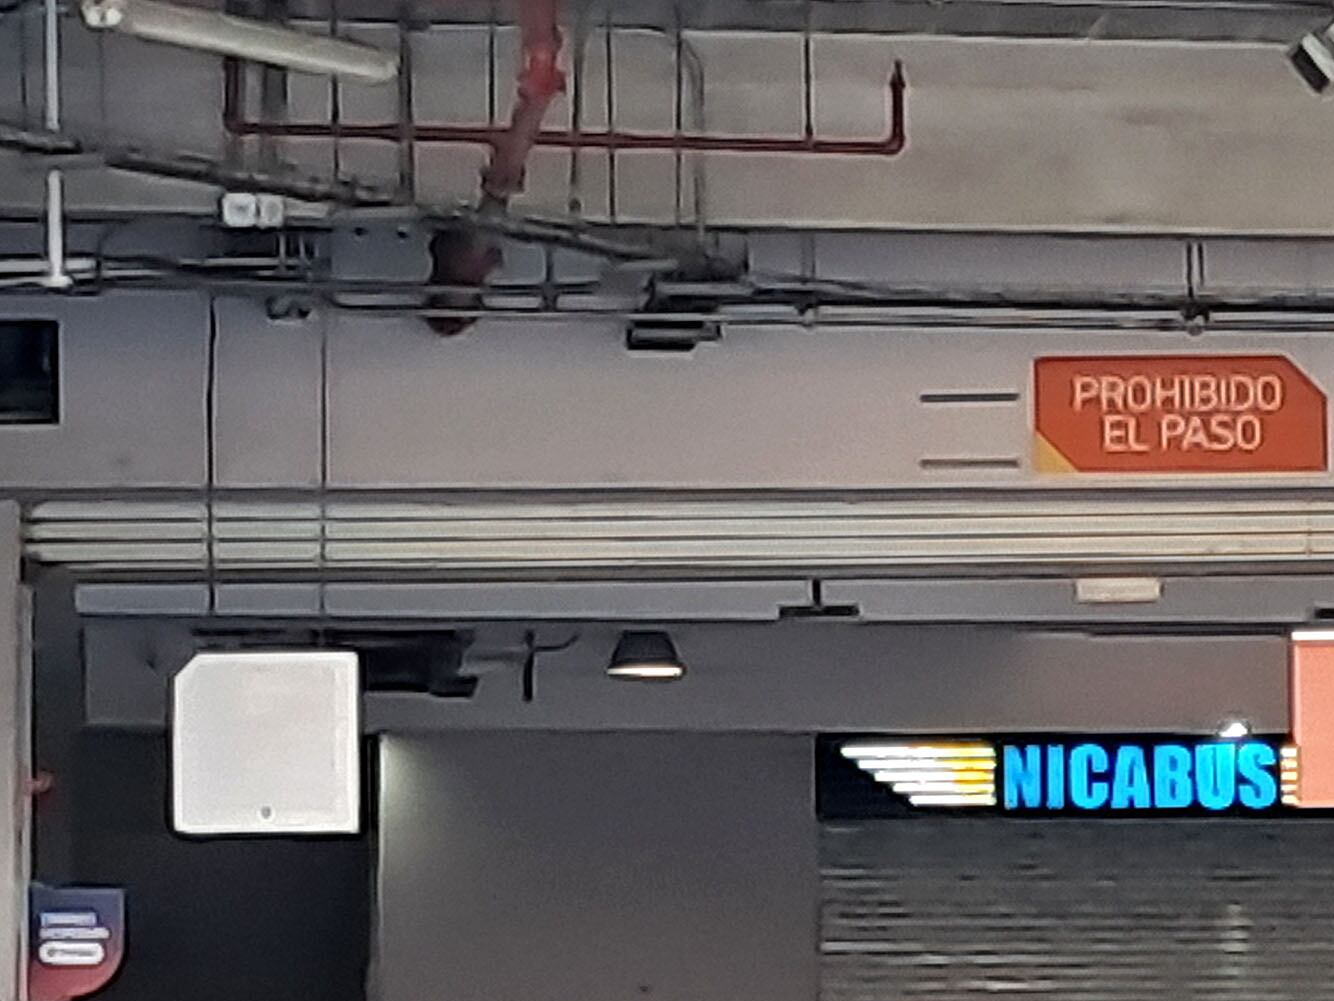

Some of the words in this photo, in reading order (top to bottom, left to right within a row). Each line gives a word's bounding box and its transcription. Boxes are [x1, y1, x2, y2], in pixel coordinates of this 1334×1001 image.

[1073, 375, 1283, 412] PROHIBIDO
[1104, 415, 1149, 451] EL
[1161, 414, 1261, 451] PASO
[1002, 743, 1277, 810] NICABUS
